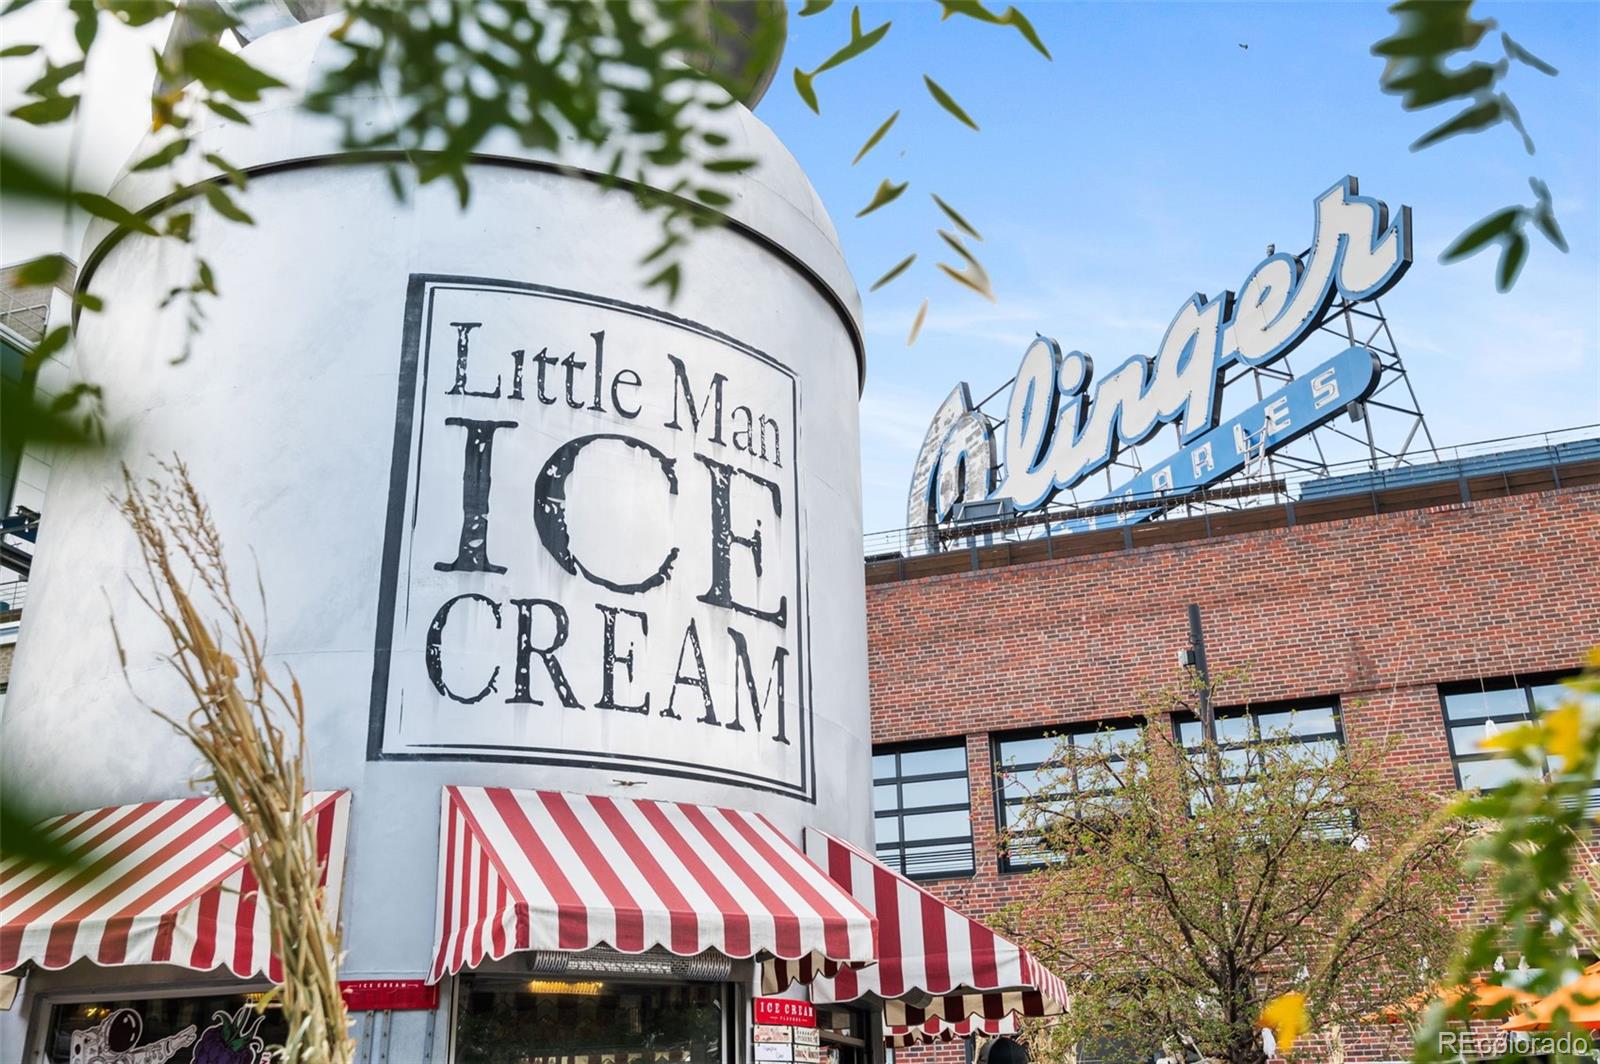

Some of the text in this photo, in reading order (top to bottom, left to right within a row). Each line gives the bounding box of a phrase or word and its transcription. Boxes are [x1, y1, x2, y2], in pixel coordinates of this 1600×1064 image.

[444, 321, 784, 468] Little Man
[433, 416, 788, 629] ICE
[425, 592, 791, 746] CREAM
[760, 1002, 813, 1017] ICE CREAM
